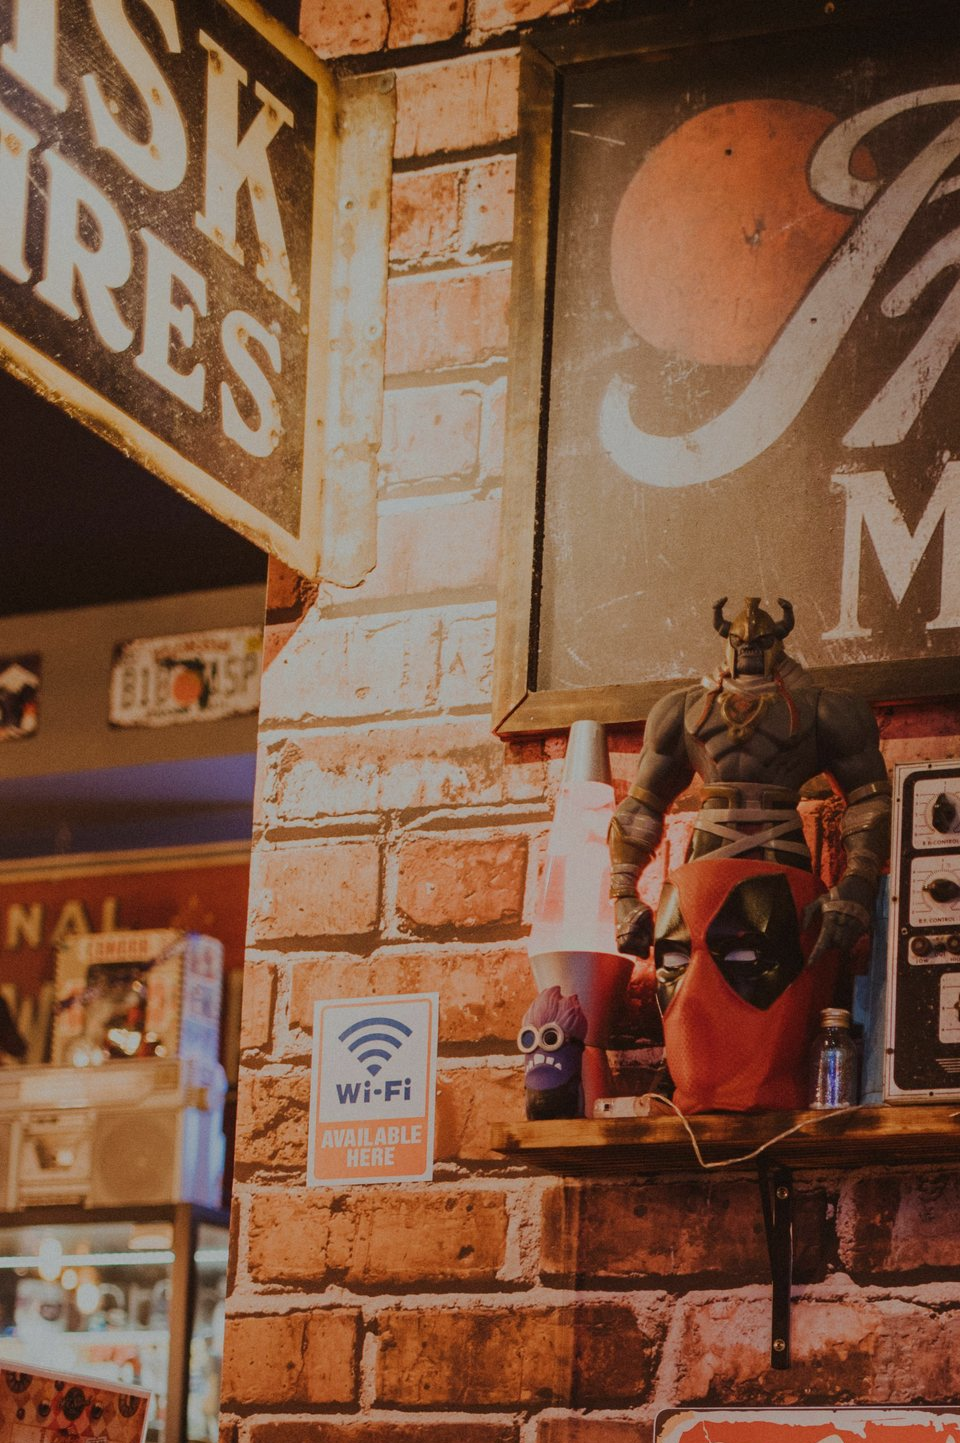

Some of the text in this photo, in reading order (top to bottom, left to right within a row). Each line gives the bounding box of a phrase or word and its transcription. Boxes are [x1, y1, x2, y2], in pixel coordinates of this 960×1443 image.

[336, 1077, 412, 1104] Wi-Fi
[321, 1124, 423, 1149] AVAILABLE
[346, 1146, 395, 1168] HERE
